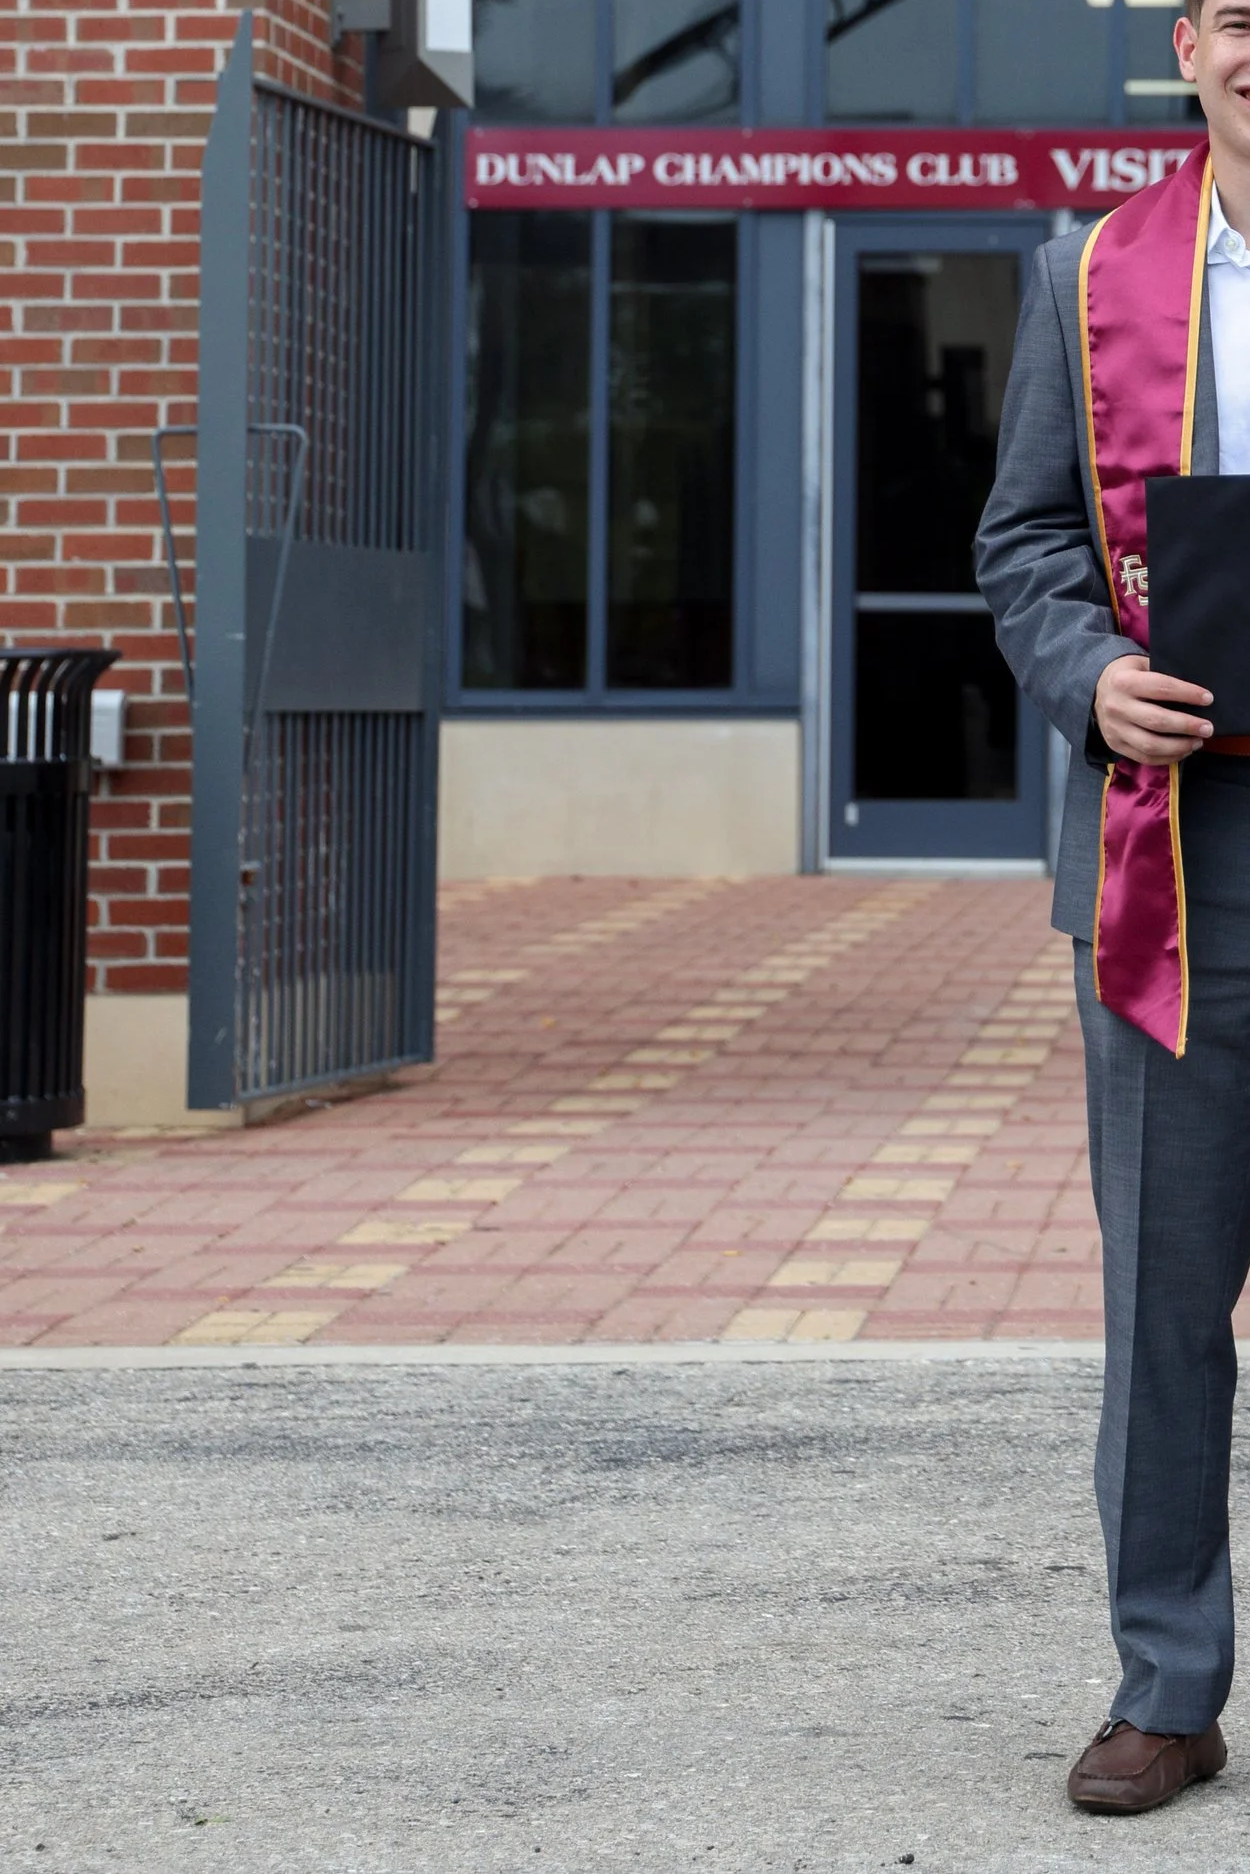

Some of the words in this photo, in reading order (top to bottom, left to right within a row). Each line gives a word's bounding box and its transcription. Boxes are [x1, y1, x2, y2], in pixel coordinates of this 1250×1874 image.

[475, 152, 645, 186] DUNLAP
[652, 152, 898, 186] CHAMPIONS
[906, 152, 1019, 186] CLUB
